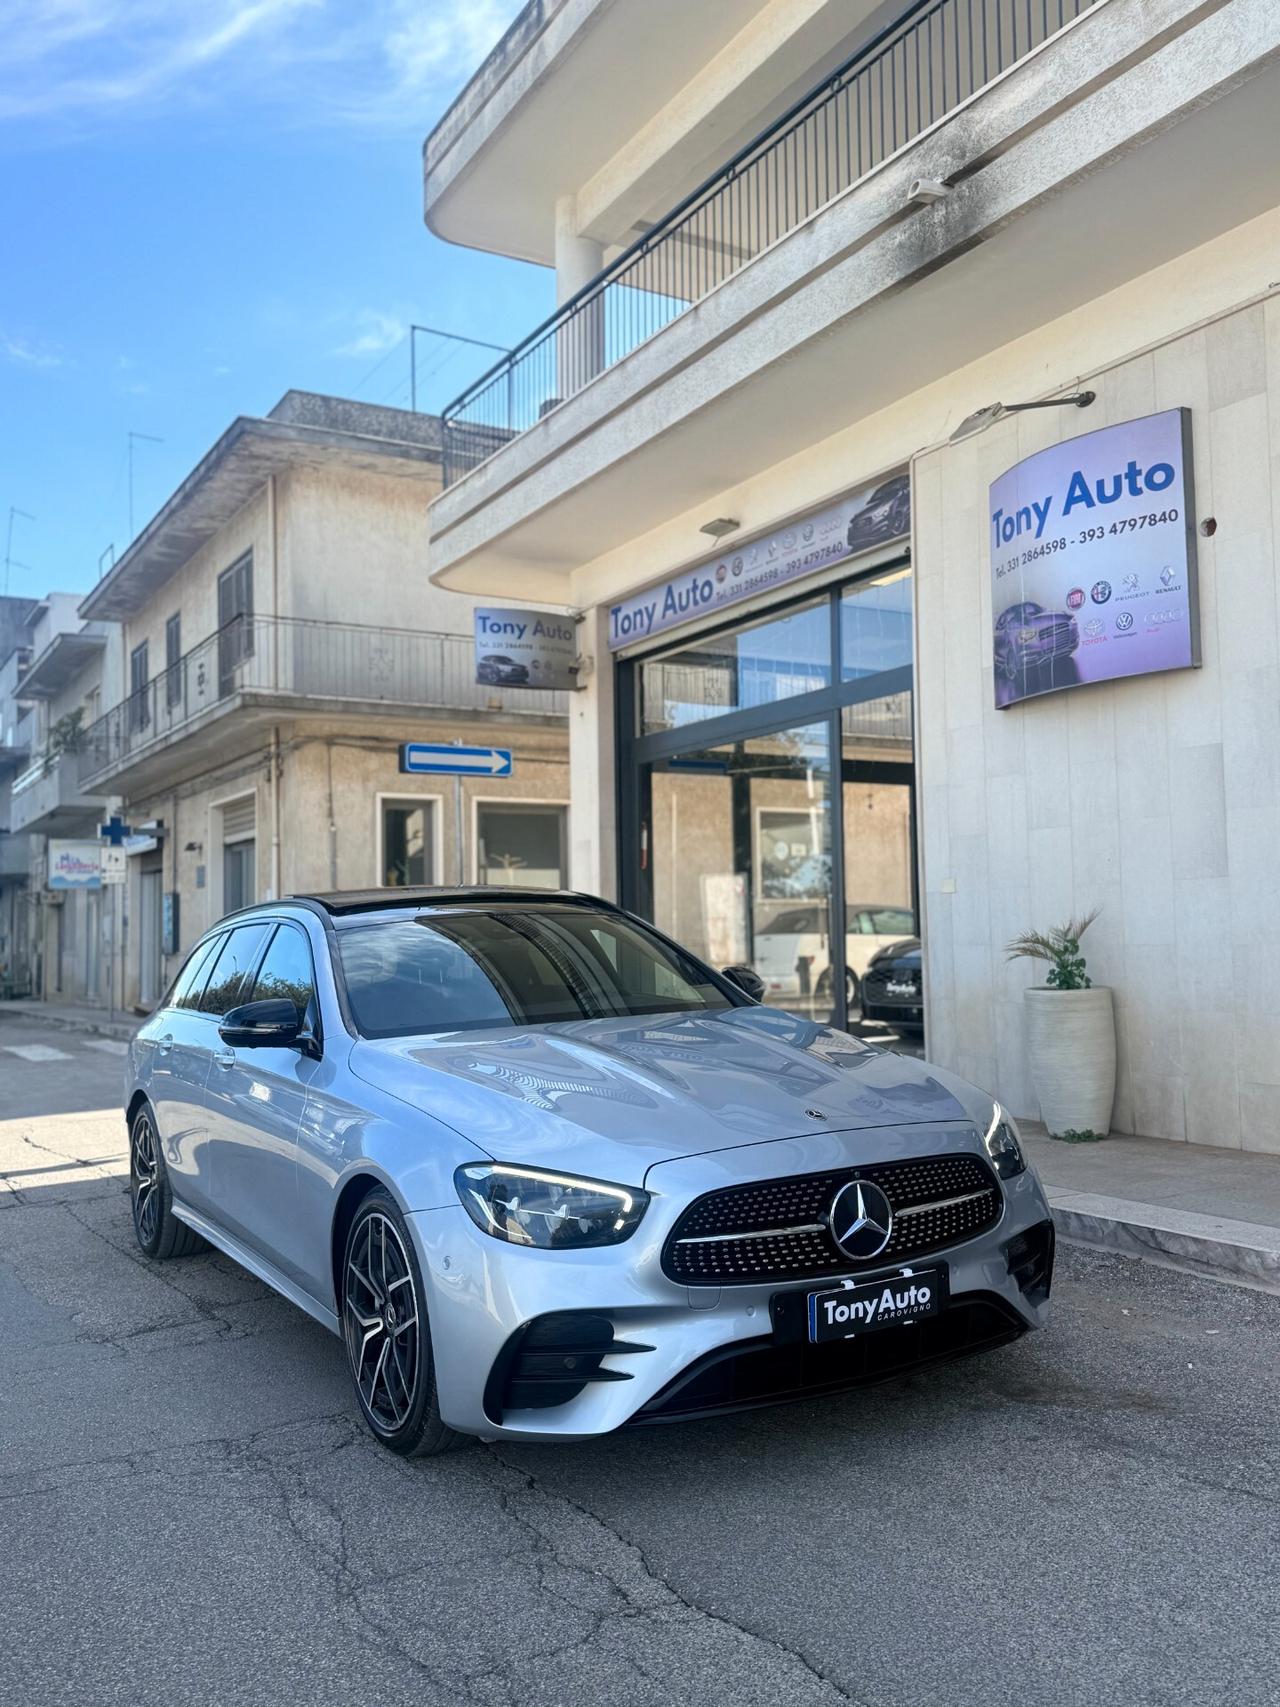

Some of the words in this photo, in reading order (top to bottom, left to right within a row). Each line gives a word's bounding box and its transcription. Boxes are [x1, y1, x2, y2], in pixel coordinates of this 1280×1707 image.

[992, 495, 1052, 548] Tony
[1062, 460, 1175, 517] Auto
[1007, 556, 1019, 573] 331
[1022, 537, 1066, 565] 2864598
[1079, 527, 1104, 545] 393
[1108, 509, 1178, 536] 4797840
[1115, 591, 1150, 602] PEUGEOT
[1155, 585, 1181, 595] RENAULT
[610, 602, 656, 639] Tony
[662, 577, 713, 620] Auto
[478, 616, 527, 640] Tony
[532, 619, 573, 641] Auto
[823, 1285, 931, 1325] TonyAuto
[877, 1303, 931, 1321] CAROVIGNO
